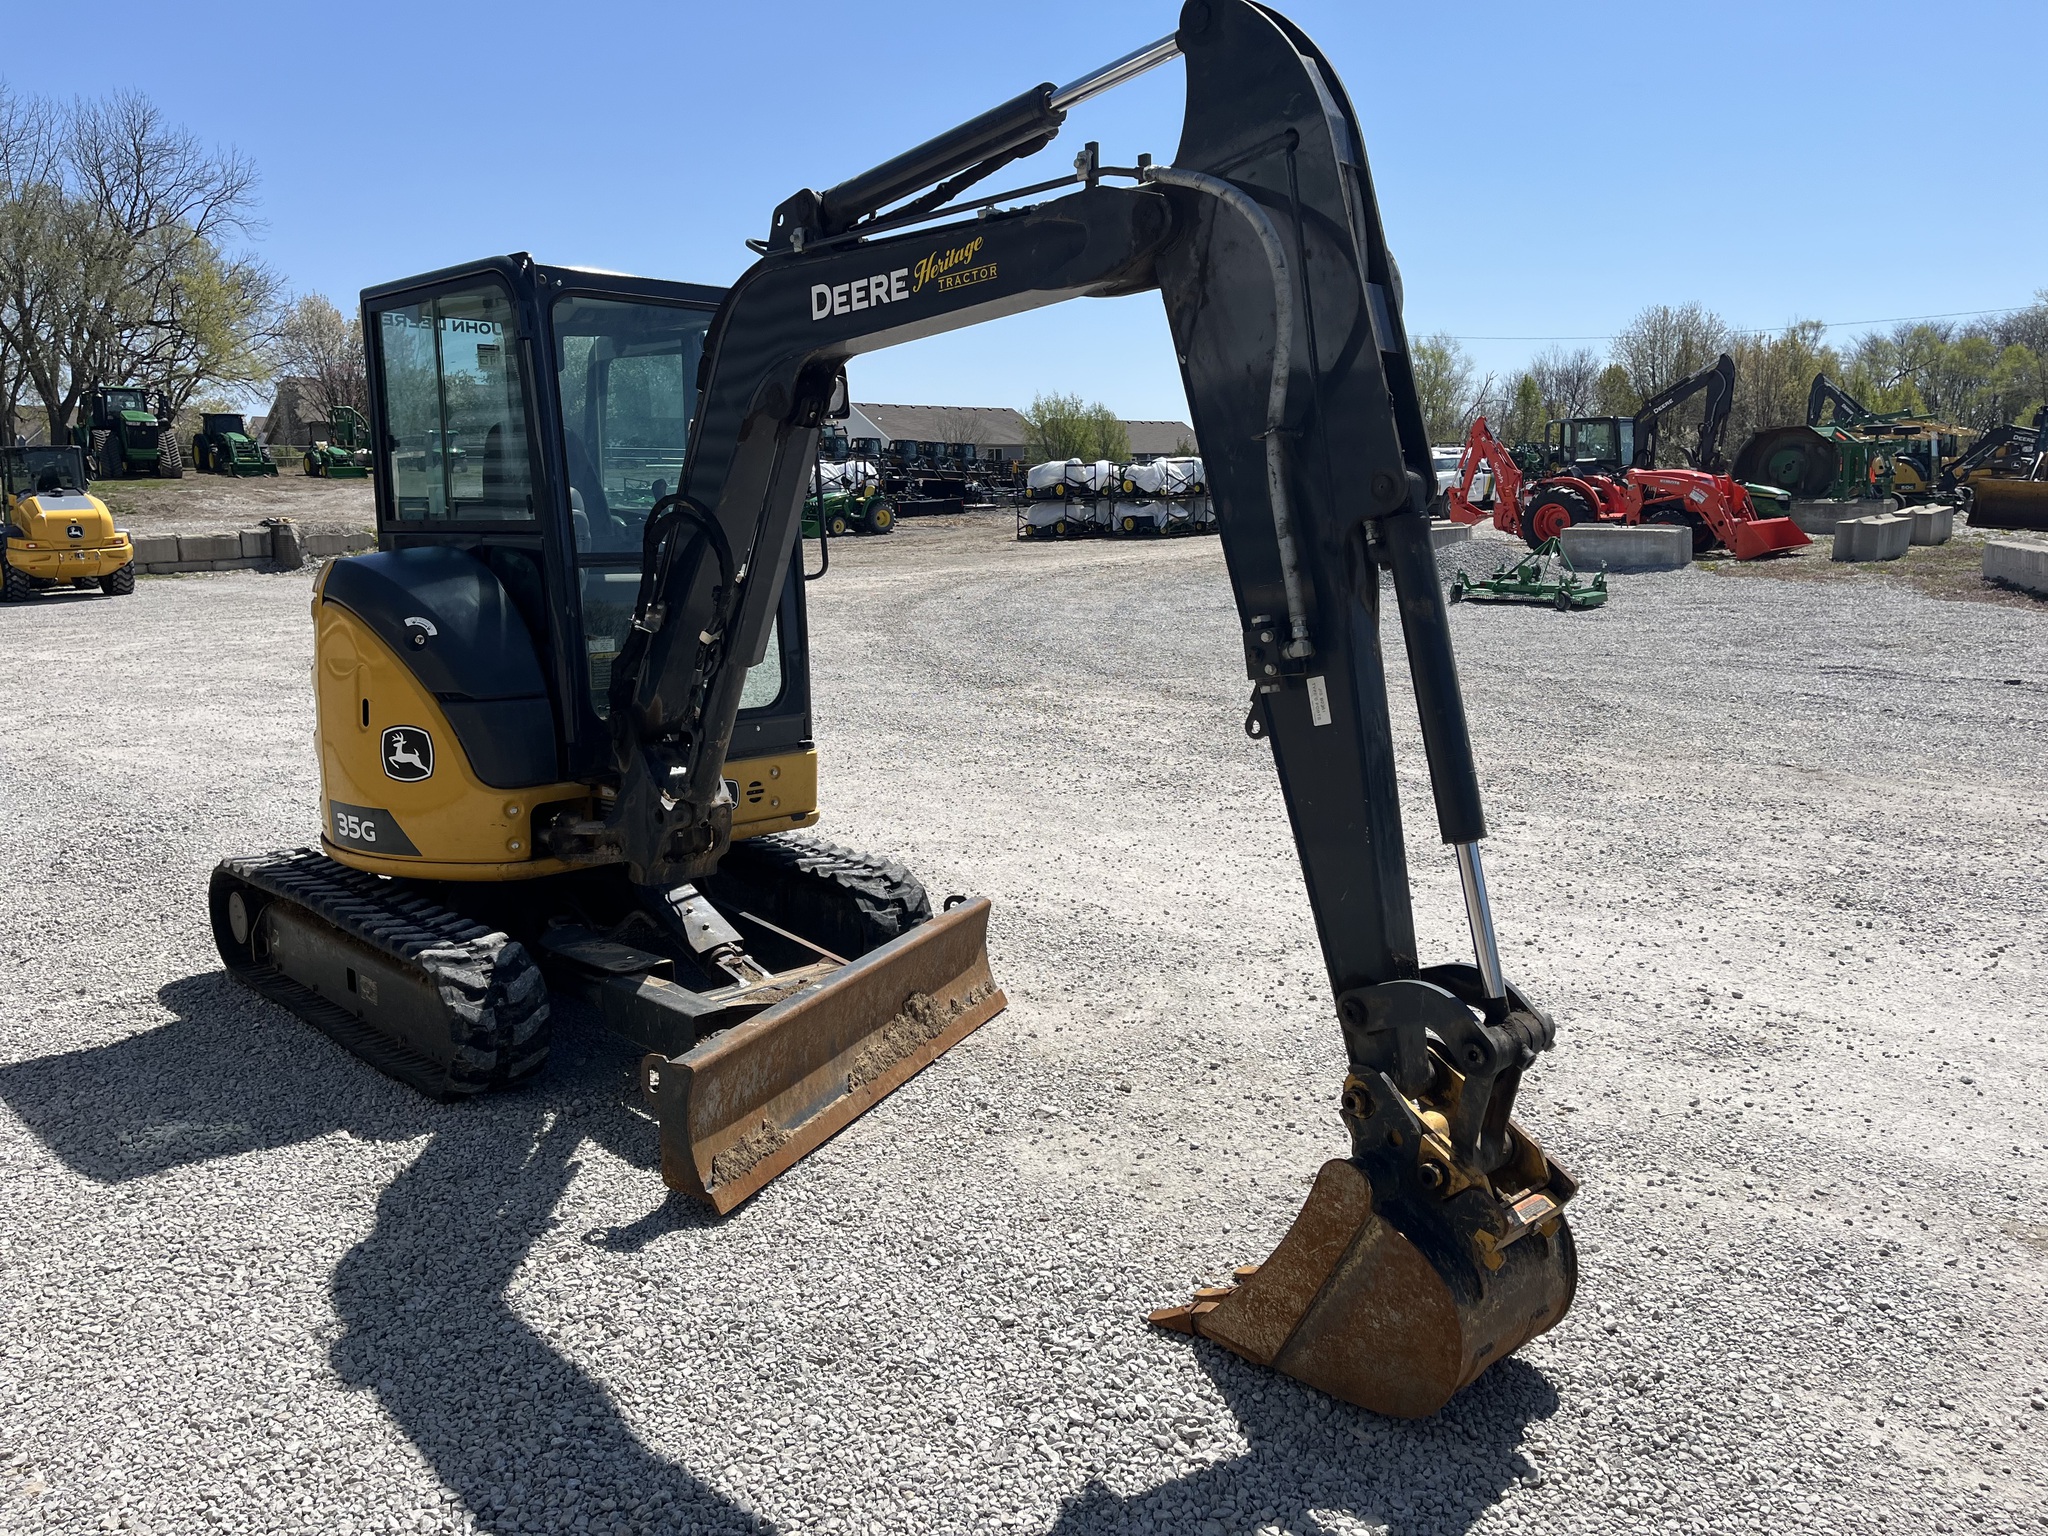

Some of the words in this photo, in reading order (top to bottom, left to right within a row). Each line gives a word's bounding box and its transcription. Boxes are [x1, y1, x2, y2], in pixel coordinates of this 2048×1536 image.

[913, 236, 984, 292] Heritage
[937, 265, 998, 289] TRACTOR
[811, 268, 910, 320] DEERE
[1653, 398, 1674, 414] DEERE
[2012, 434, 2036, 443] DEERE
[337, 812, 376, 842] 35G
